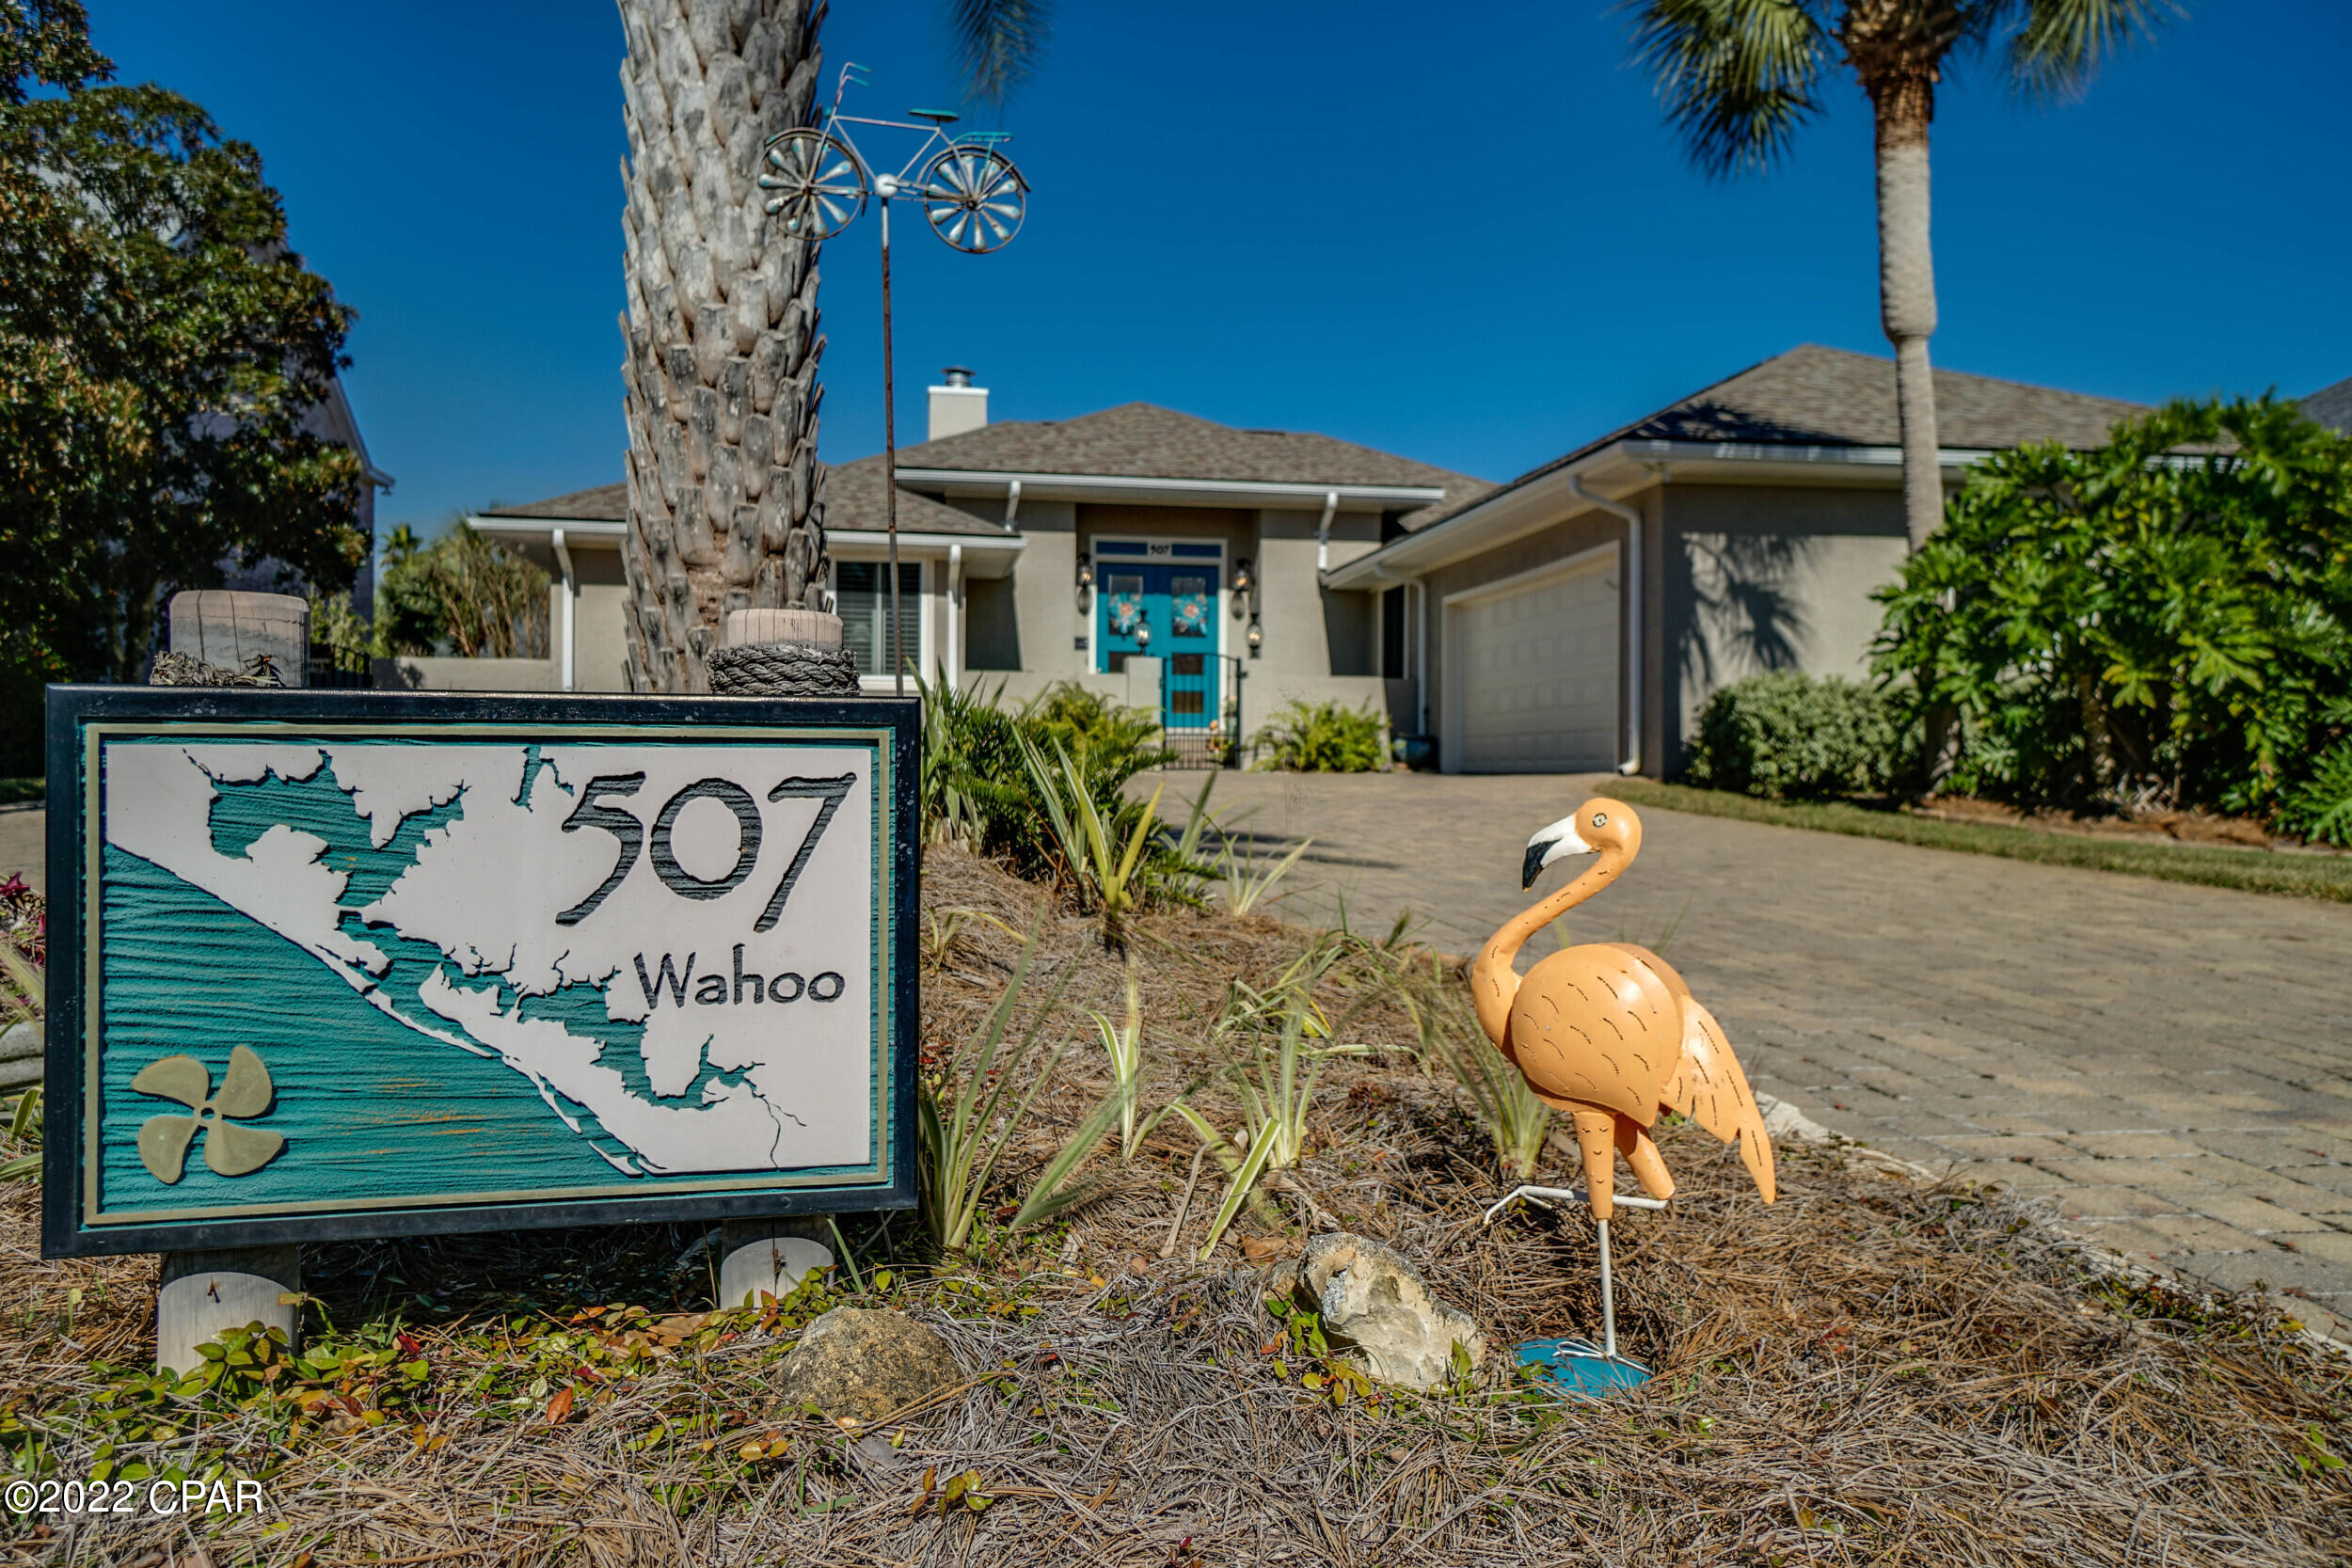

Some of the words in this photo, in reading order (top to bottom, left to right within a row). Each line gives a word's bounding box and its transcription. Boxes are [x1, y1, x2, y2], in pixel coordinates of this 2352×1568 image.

[1150, 545, 1169, 555] 507
[555, 771, 857, 933] 507
[633, 942, 846, 1010] Wahoo
